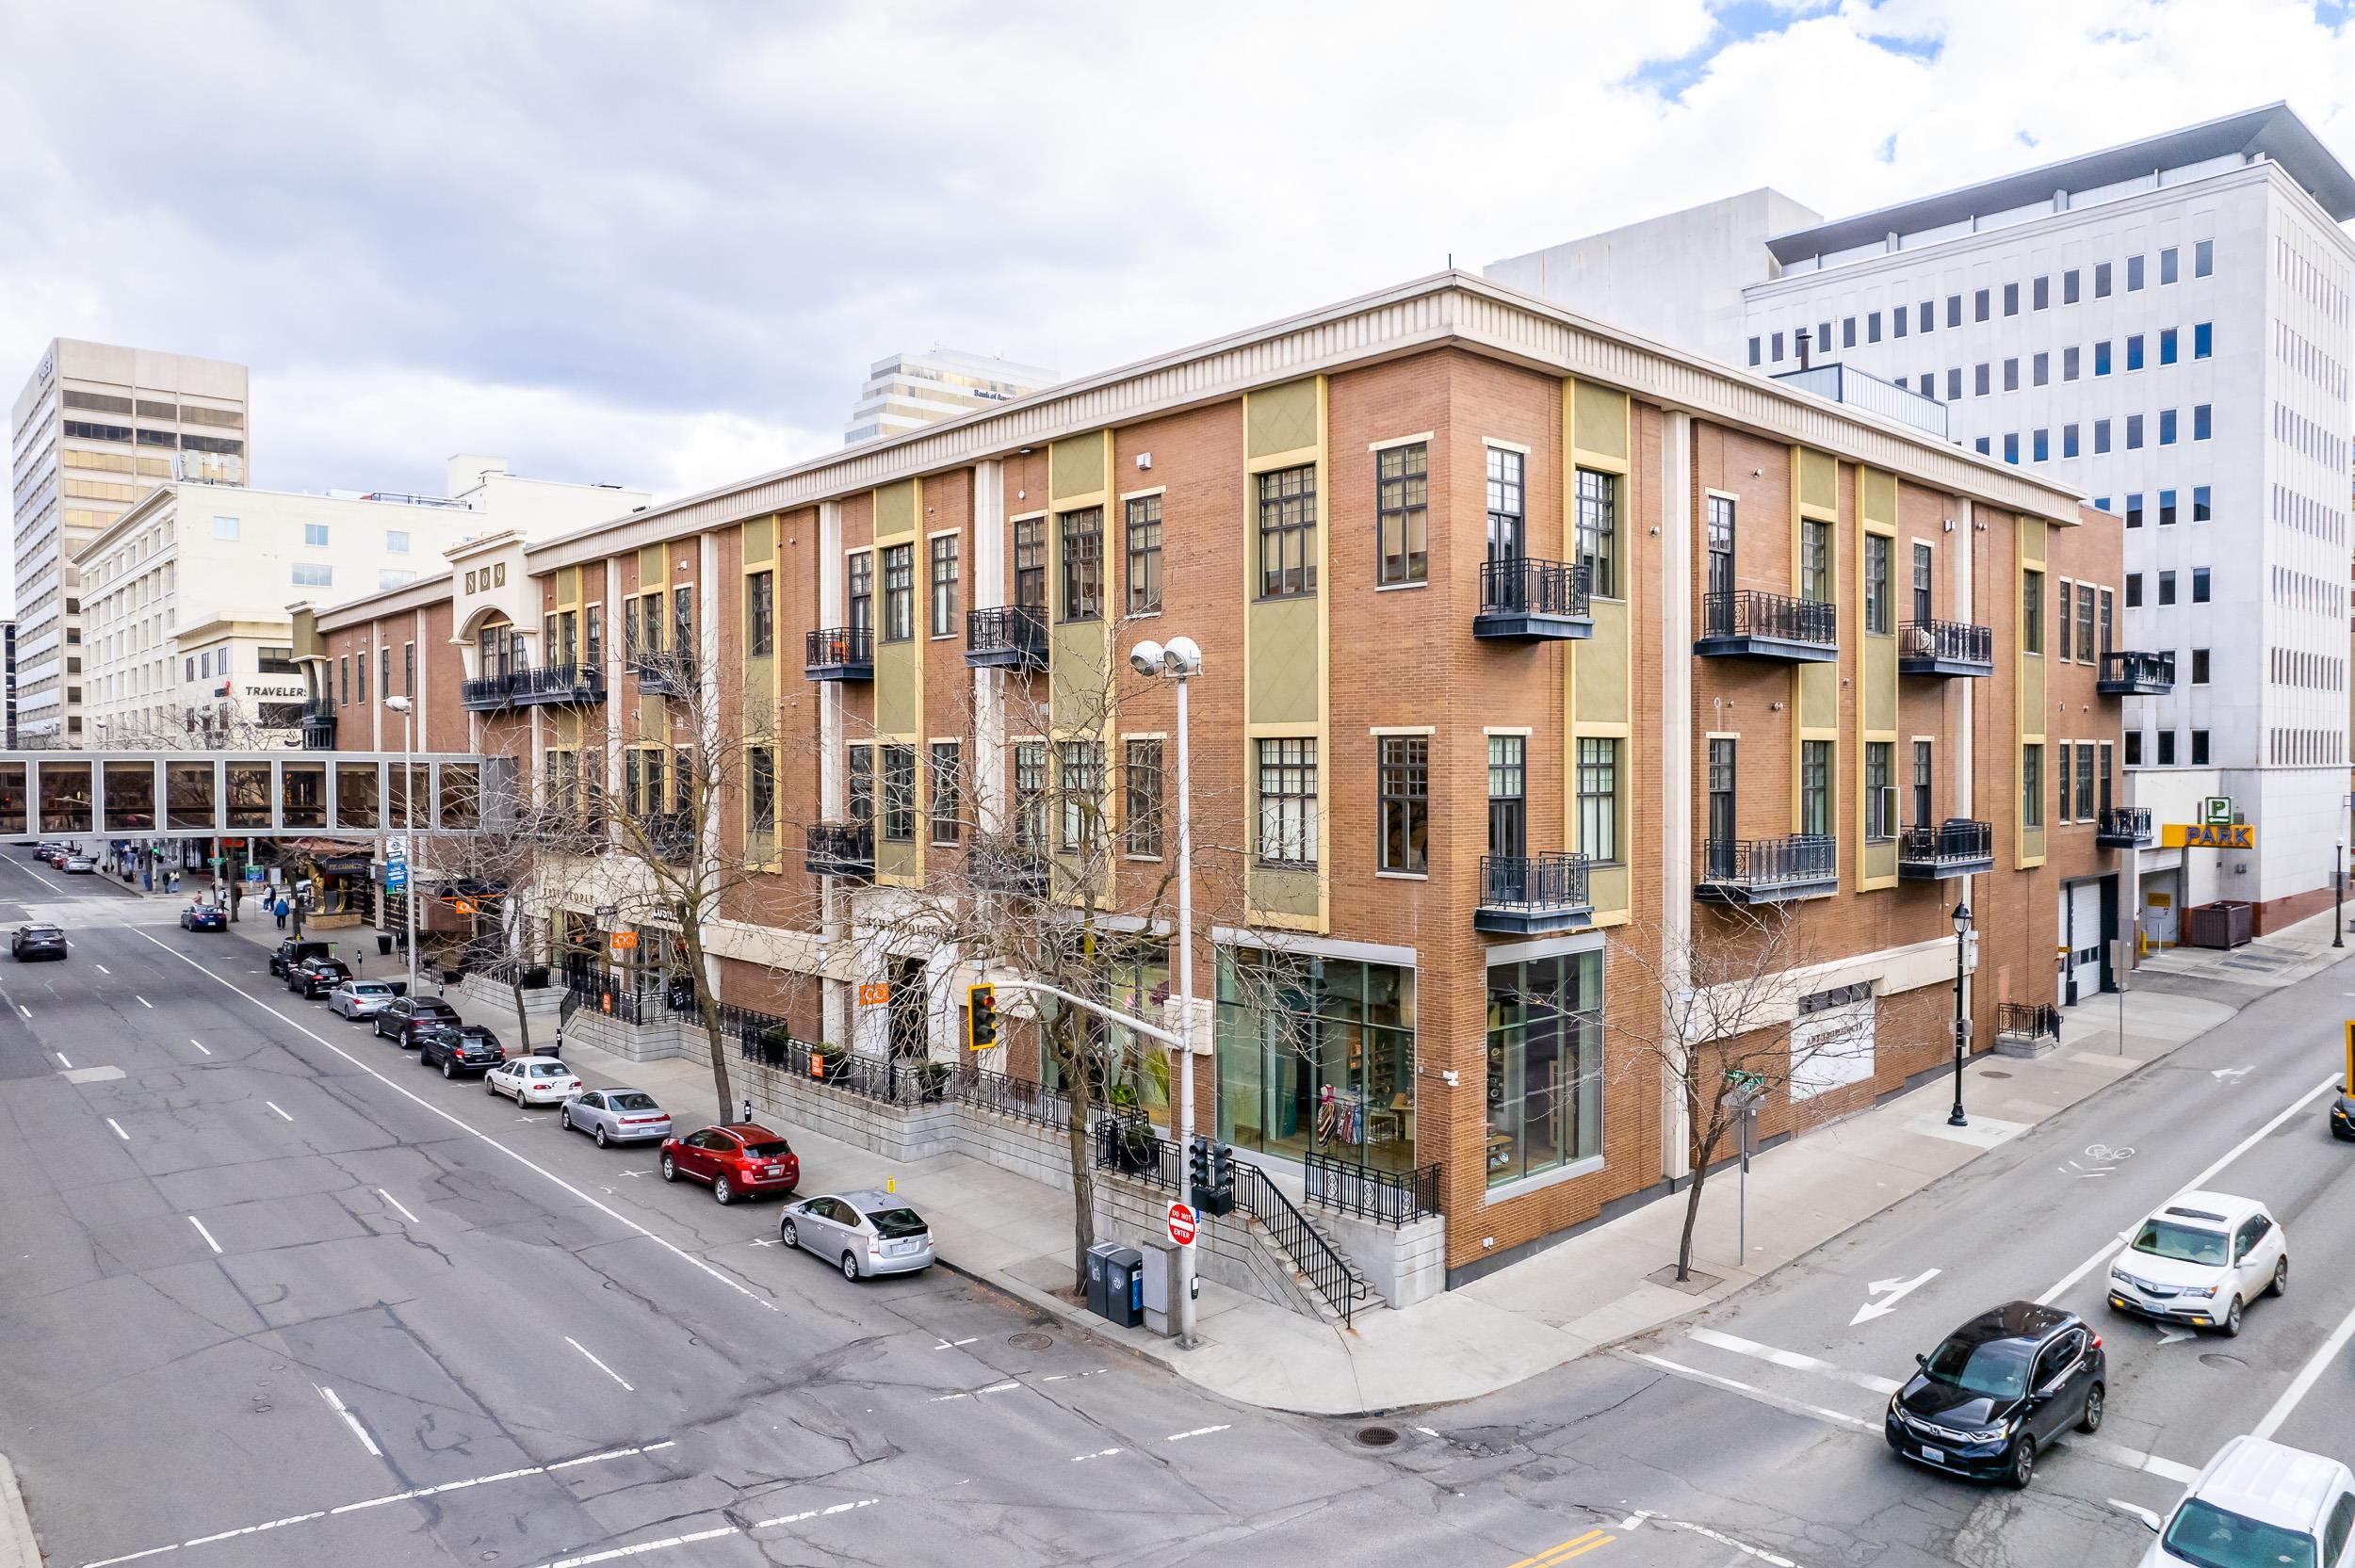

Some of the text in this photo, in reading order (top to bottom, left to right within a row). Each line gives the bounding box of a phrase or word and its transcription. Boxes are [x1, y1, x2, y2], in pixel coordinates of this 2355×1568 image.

[974, 389, 989, 399] Bank
[467, 565, 503, 593] 809
[2212, 800, 2225, 816] P
[2186, 826, 2250, 846] PARK
[1172, 1209, 1192, 1222] DO NOT
[1174, 1227, 1190, 1239] ENTER
